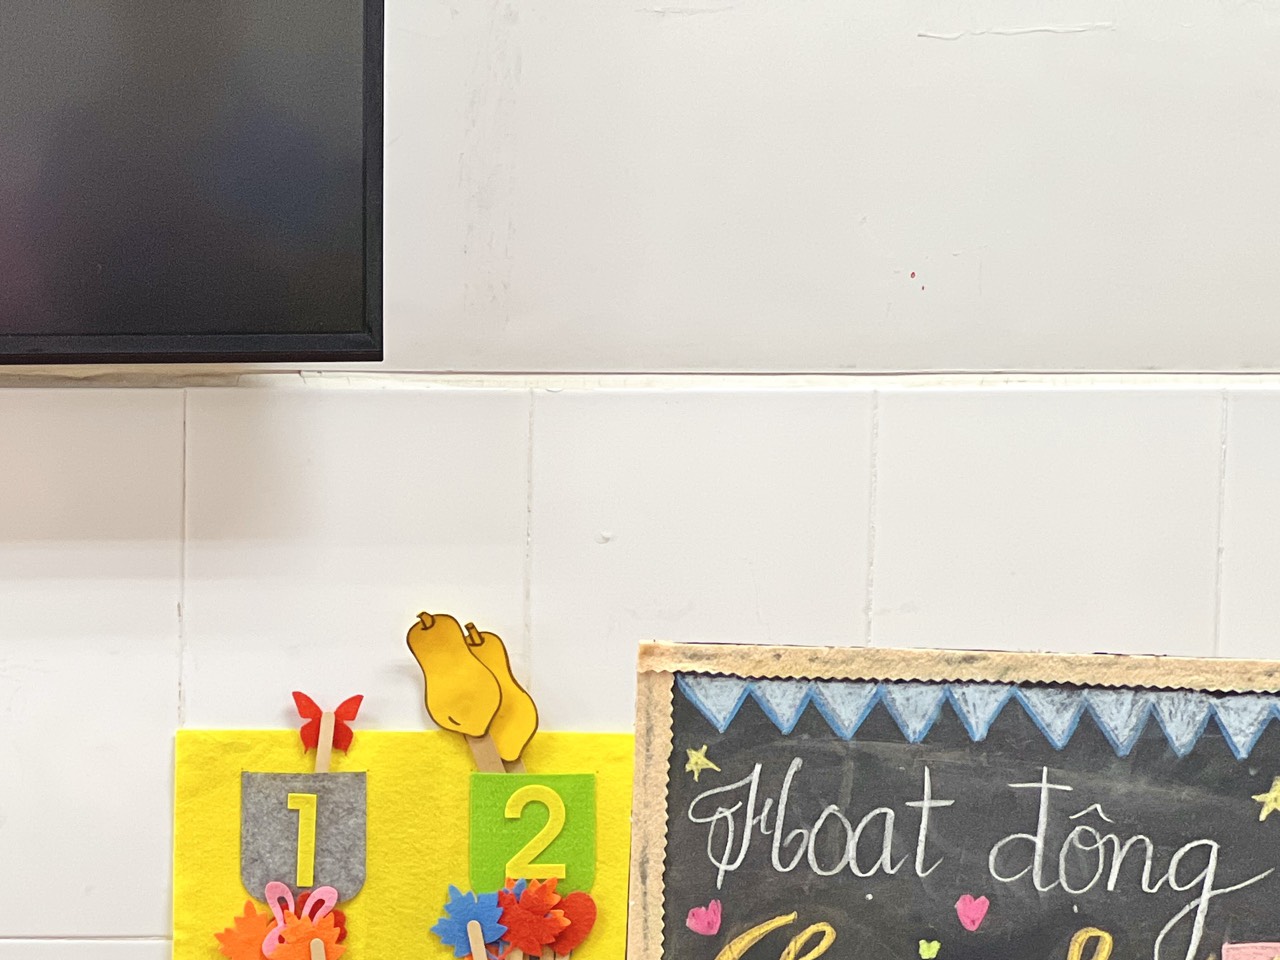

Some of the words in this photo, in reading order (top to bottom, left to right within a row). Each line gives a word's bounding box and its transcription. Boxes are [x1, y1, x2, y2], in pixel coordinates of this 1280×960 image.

[287, 793, 318, 887] 1
[504, 785, 566, 879] 2
[687, 757, 955, 901] Hoạt
